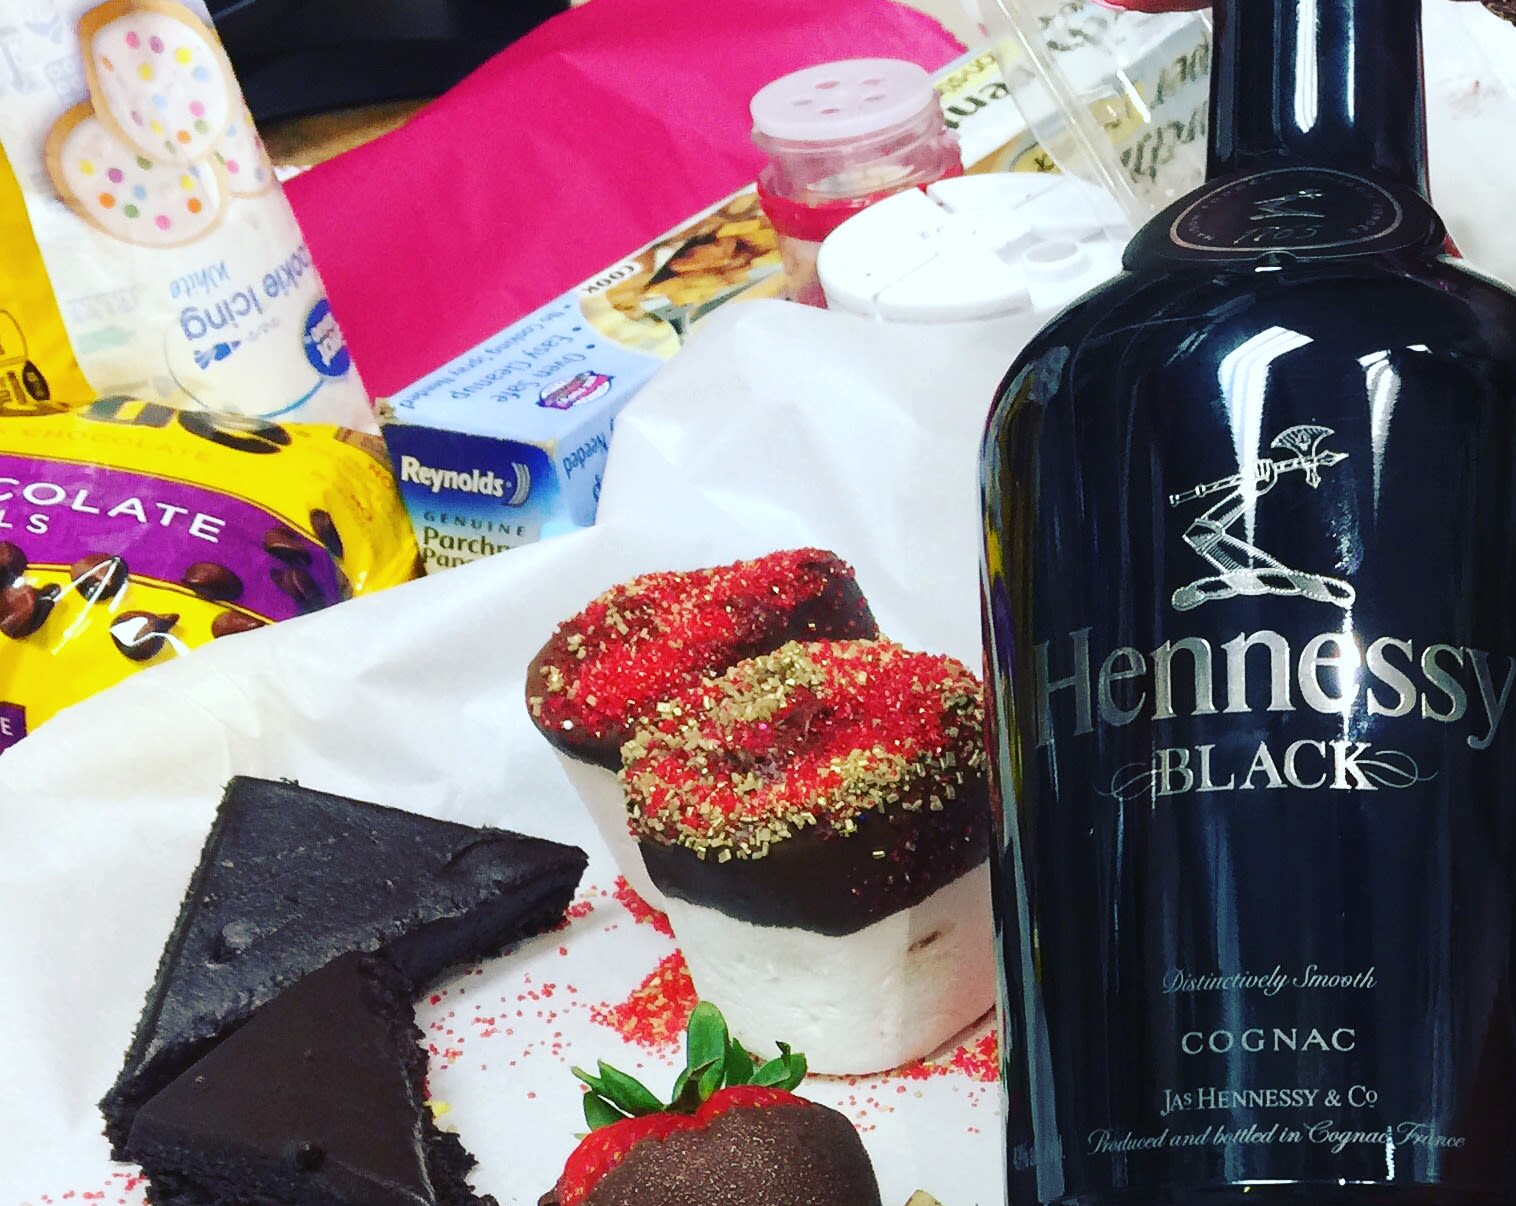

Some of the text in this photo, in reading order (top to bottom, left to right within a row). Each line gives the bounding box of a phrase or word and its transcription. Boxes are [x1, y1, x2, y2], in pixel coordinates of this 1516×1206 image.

[585, 263, 636, 294] COOK
[179, 287, 264, 341] Icing
[534, 352, 587, 379] Oven
[489, 378, 541, 403] Safe
[401, 456, 505, 498] Reynolds
[423, 511, 526, 536] GENUINE
[1155, 738, 1378, 798] BLACK
[1162, 964, 1377, 997] Distinctively Smooth
[1181, 1028, 1356, 1055] COGNAC
[1198, 1087, 1320, 1110] HENNESSY
[1324, 1089, 1342, 1107] &
[1087, 1128, 1170, 1155] Produced
[1169, 1125, 1213, 1146] and
[1213, 1123, 1279, 1145] bottled
[1279, 1126, 1301, 1143] in
[1396, 1121, 1466, 1149] France
